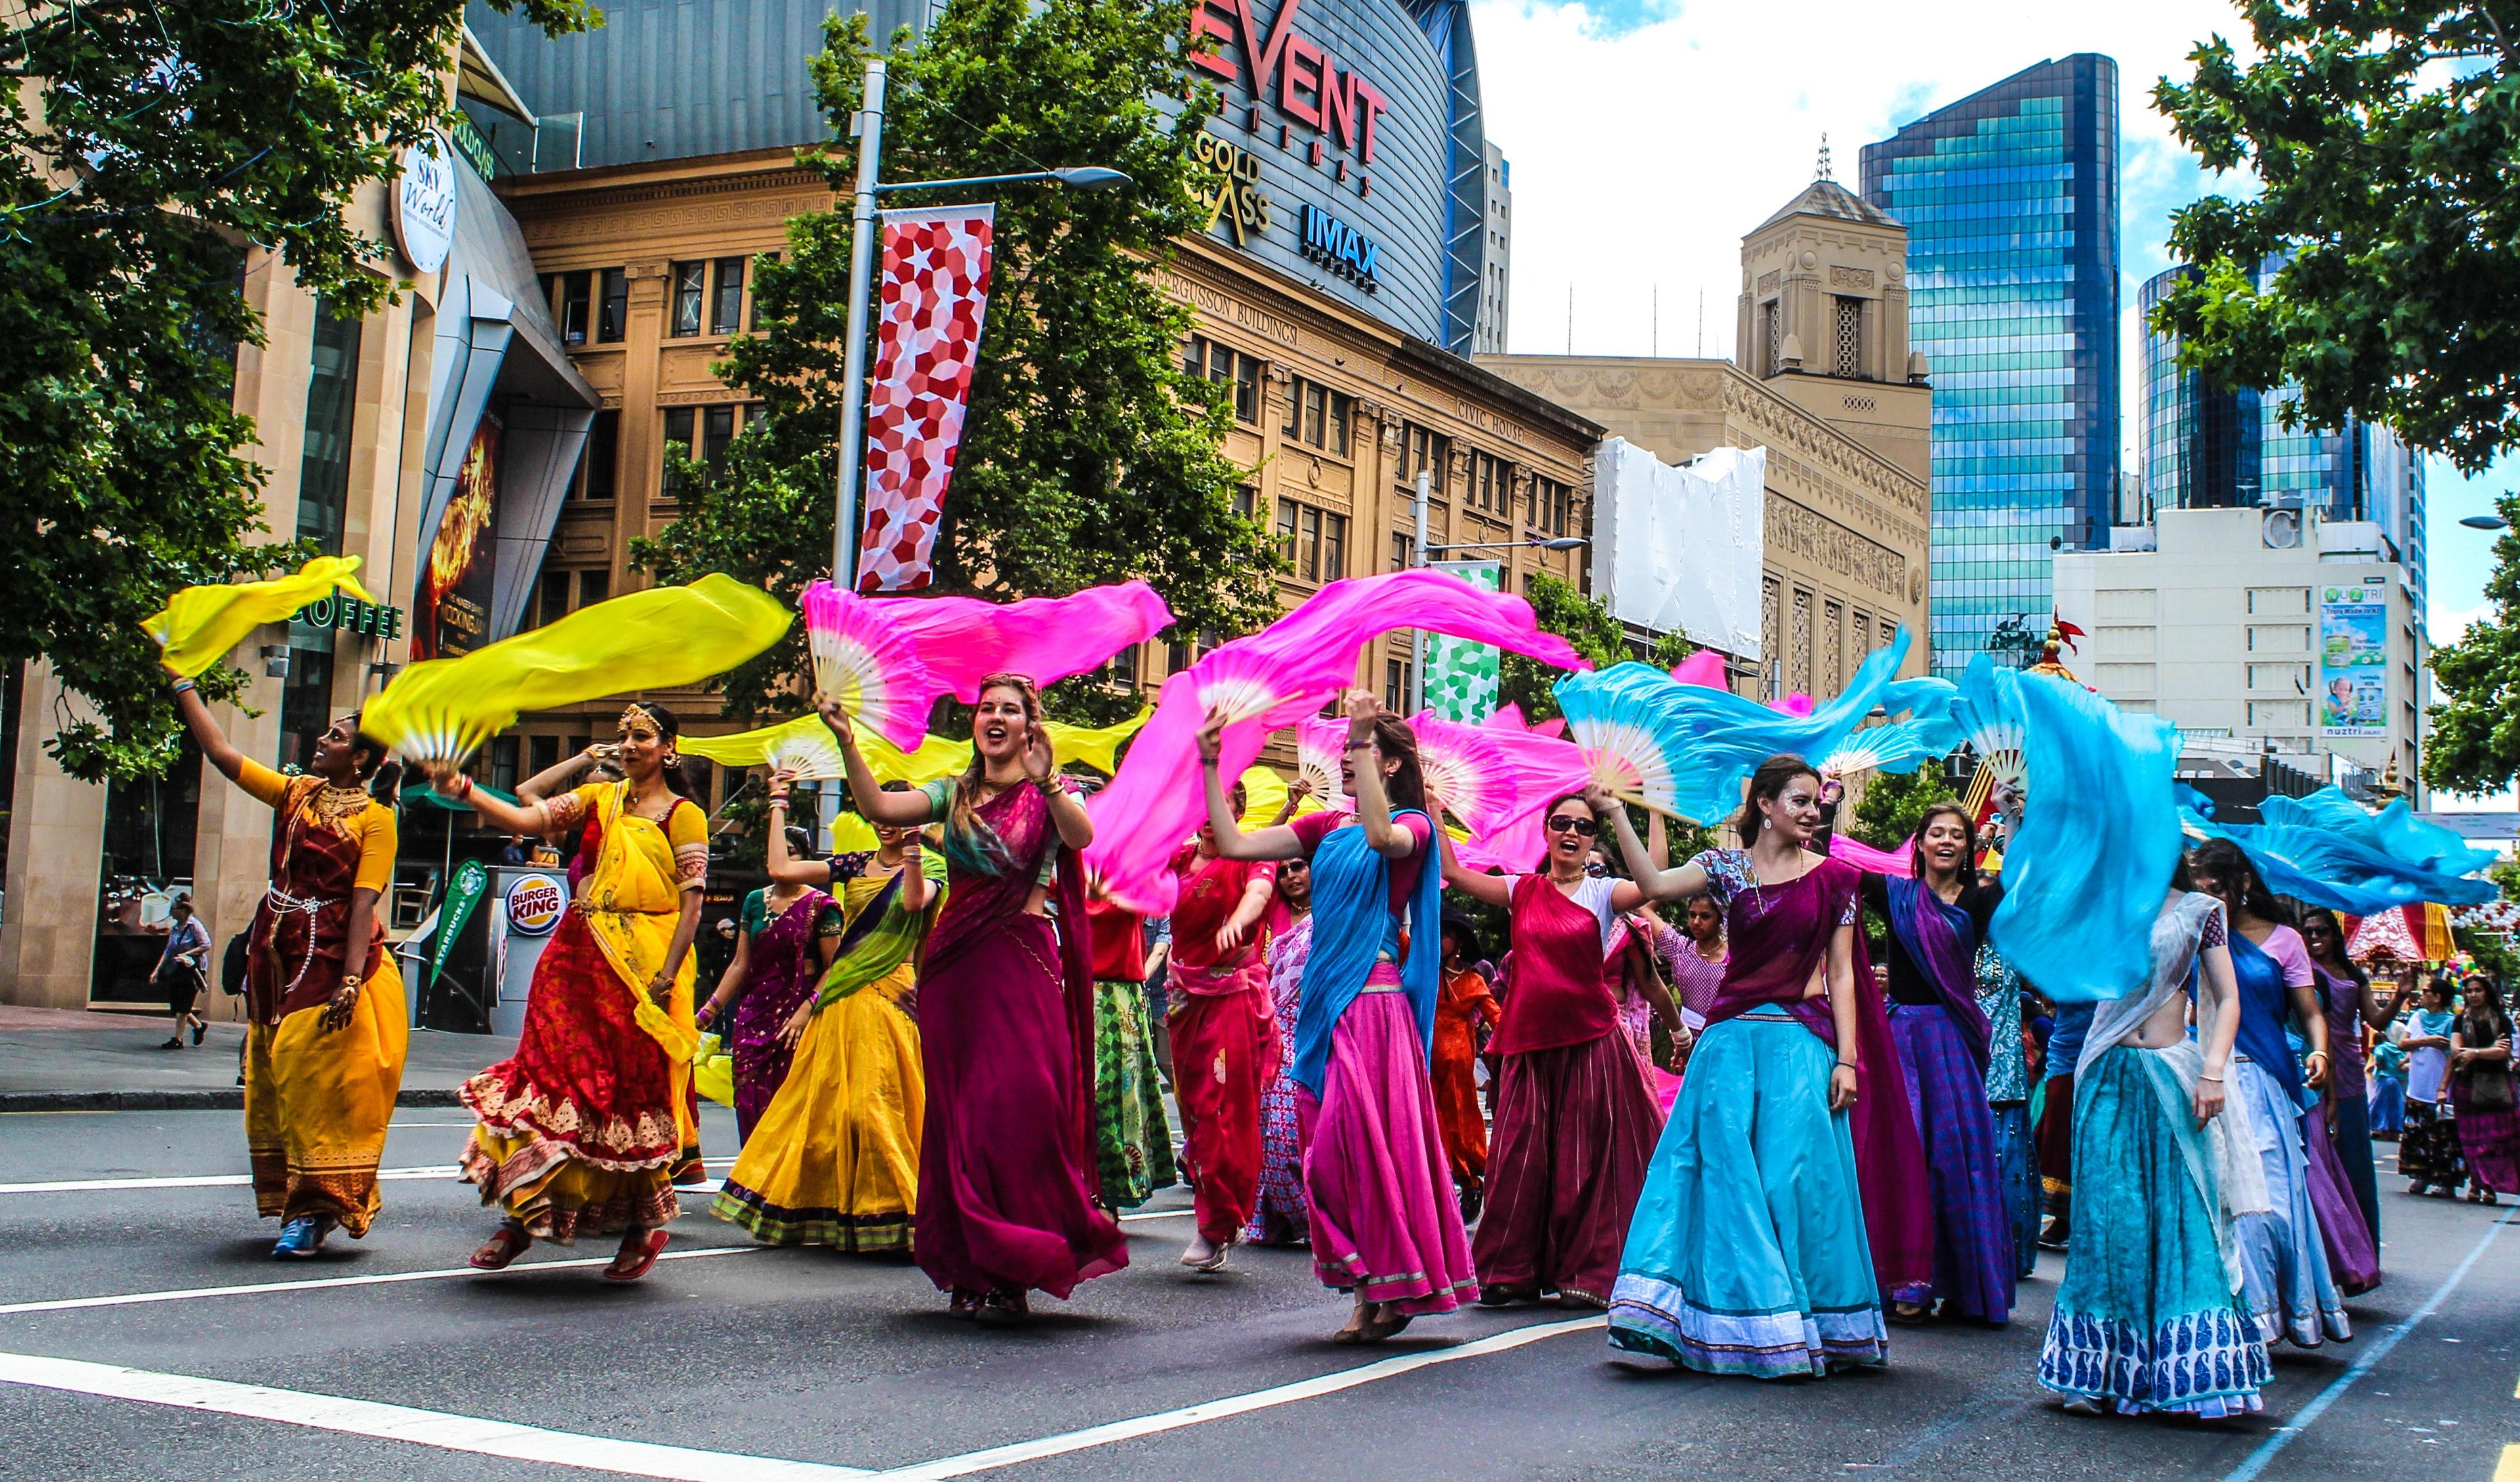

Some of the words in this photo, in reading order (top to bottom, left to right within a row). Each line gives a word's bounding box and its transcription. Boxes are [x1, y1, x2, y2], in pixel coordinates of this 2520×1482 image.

[1188, 0, 1387, 163] EVENT
[418, 159, 442, 194] SKY
[1196, 131, 1261, 185] GOLD
[405, 182, 453, 230] World
[1307, 204, 1379, 281] IMAX
[1157, 268, 1232, 317] FERGUSSON
[1238, 303, 1296, 347] BUILDINGS
[1458, 402, 1486, 427] CIVIC
[1492, 415, 1524, 442] HOUSE
[512, 887, 557, 907] BURGER
[513, 897, 558, 921] KING
[436, 900, 466, 965] STARBUCKS
